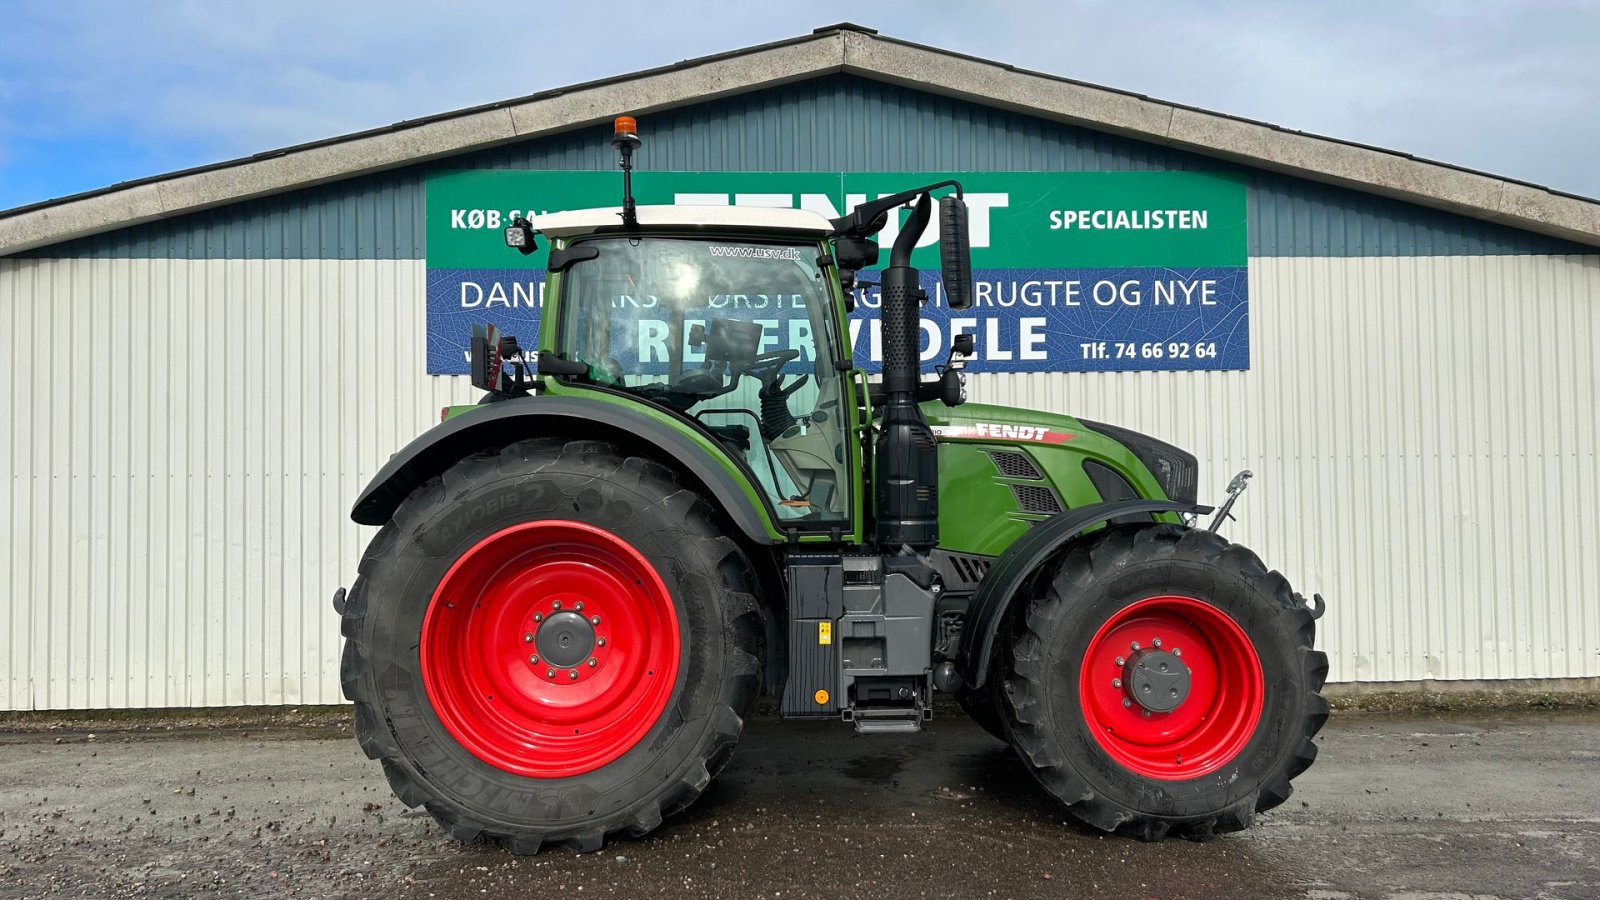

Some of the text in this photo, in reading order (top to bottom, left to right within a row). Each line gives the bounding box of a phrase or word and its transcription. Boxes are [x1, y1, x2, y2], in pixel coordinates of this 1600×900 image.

[1049, 210, 1208, 230] SPECIALISTEN
[709, 246, 801, 261] www.usv.dk
[976, 281, 1081, 307] RUGTE
[1093, 280, 1141, 306] OG
[1155, 280, 1217, 305] NYE
[1080, 343, 1217, 359] Tlf. 74 66 92 64
[976, 423, 1050, 441] FENDT
